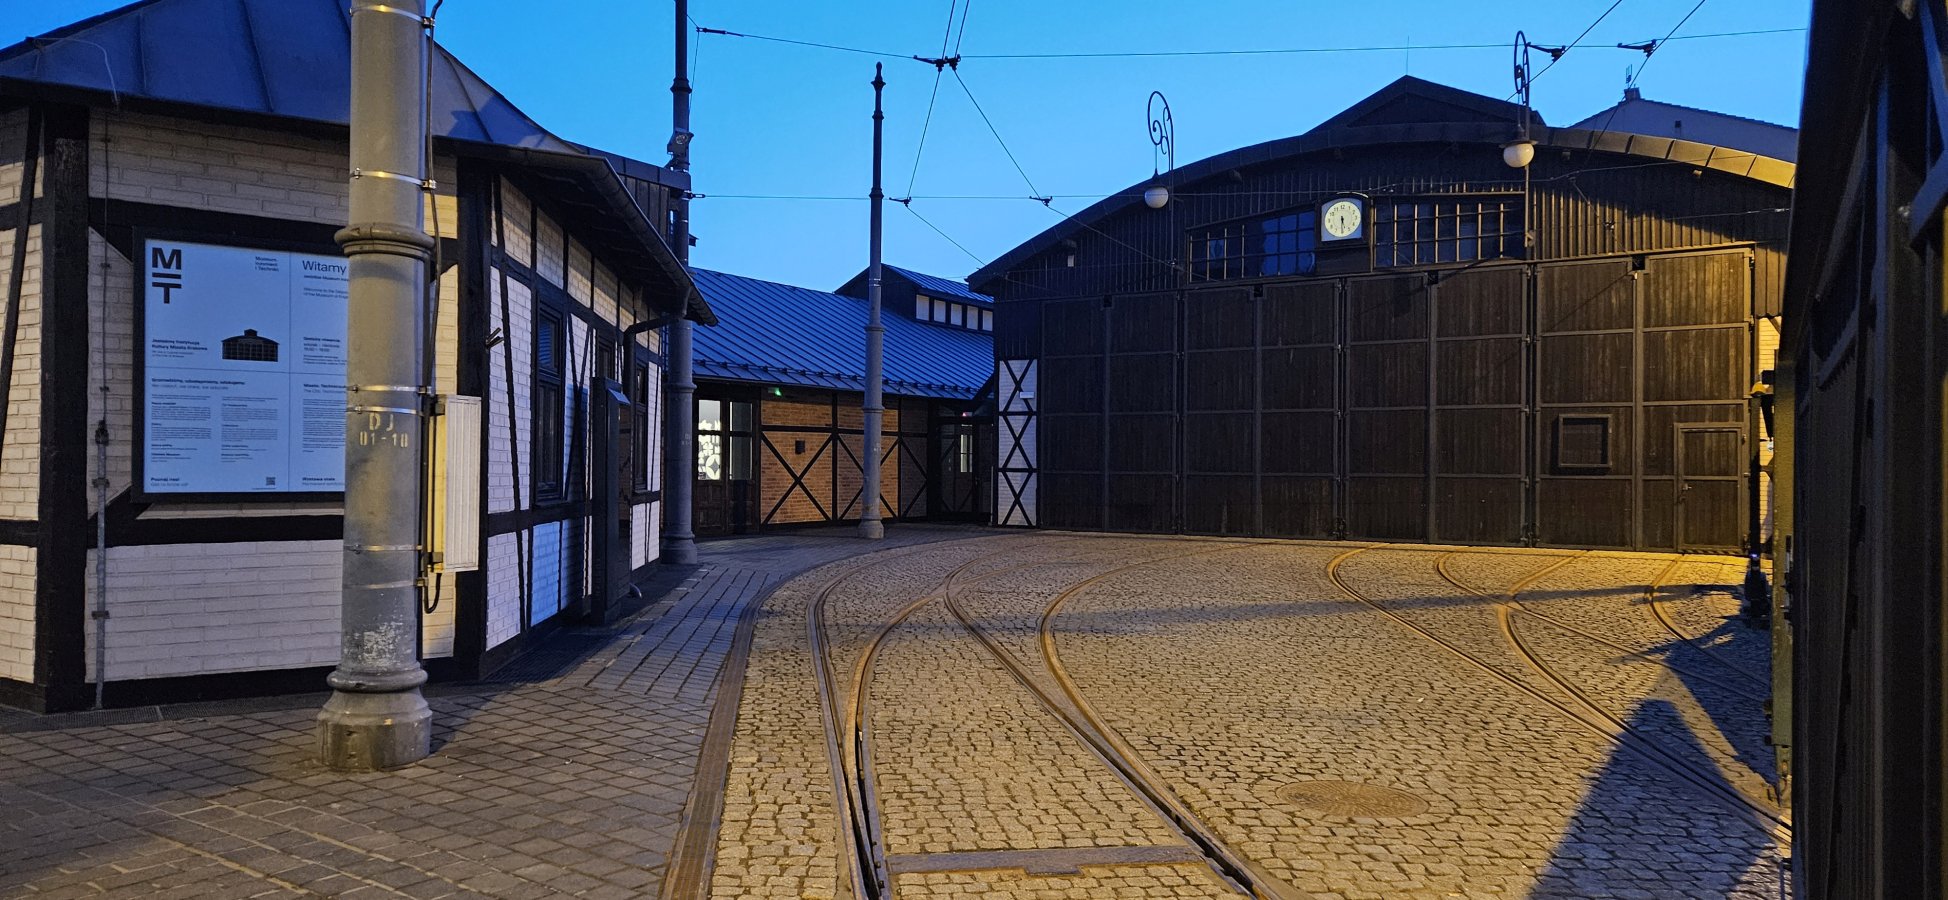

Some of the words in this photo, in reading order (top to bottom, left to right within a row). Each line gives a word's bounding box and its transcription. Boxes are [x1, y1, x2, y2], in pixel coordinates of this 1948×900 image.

[152, 247, 182, 270] M
[302, 260, 347, 275] Witamy
[152, 281, 182, 304] T
